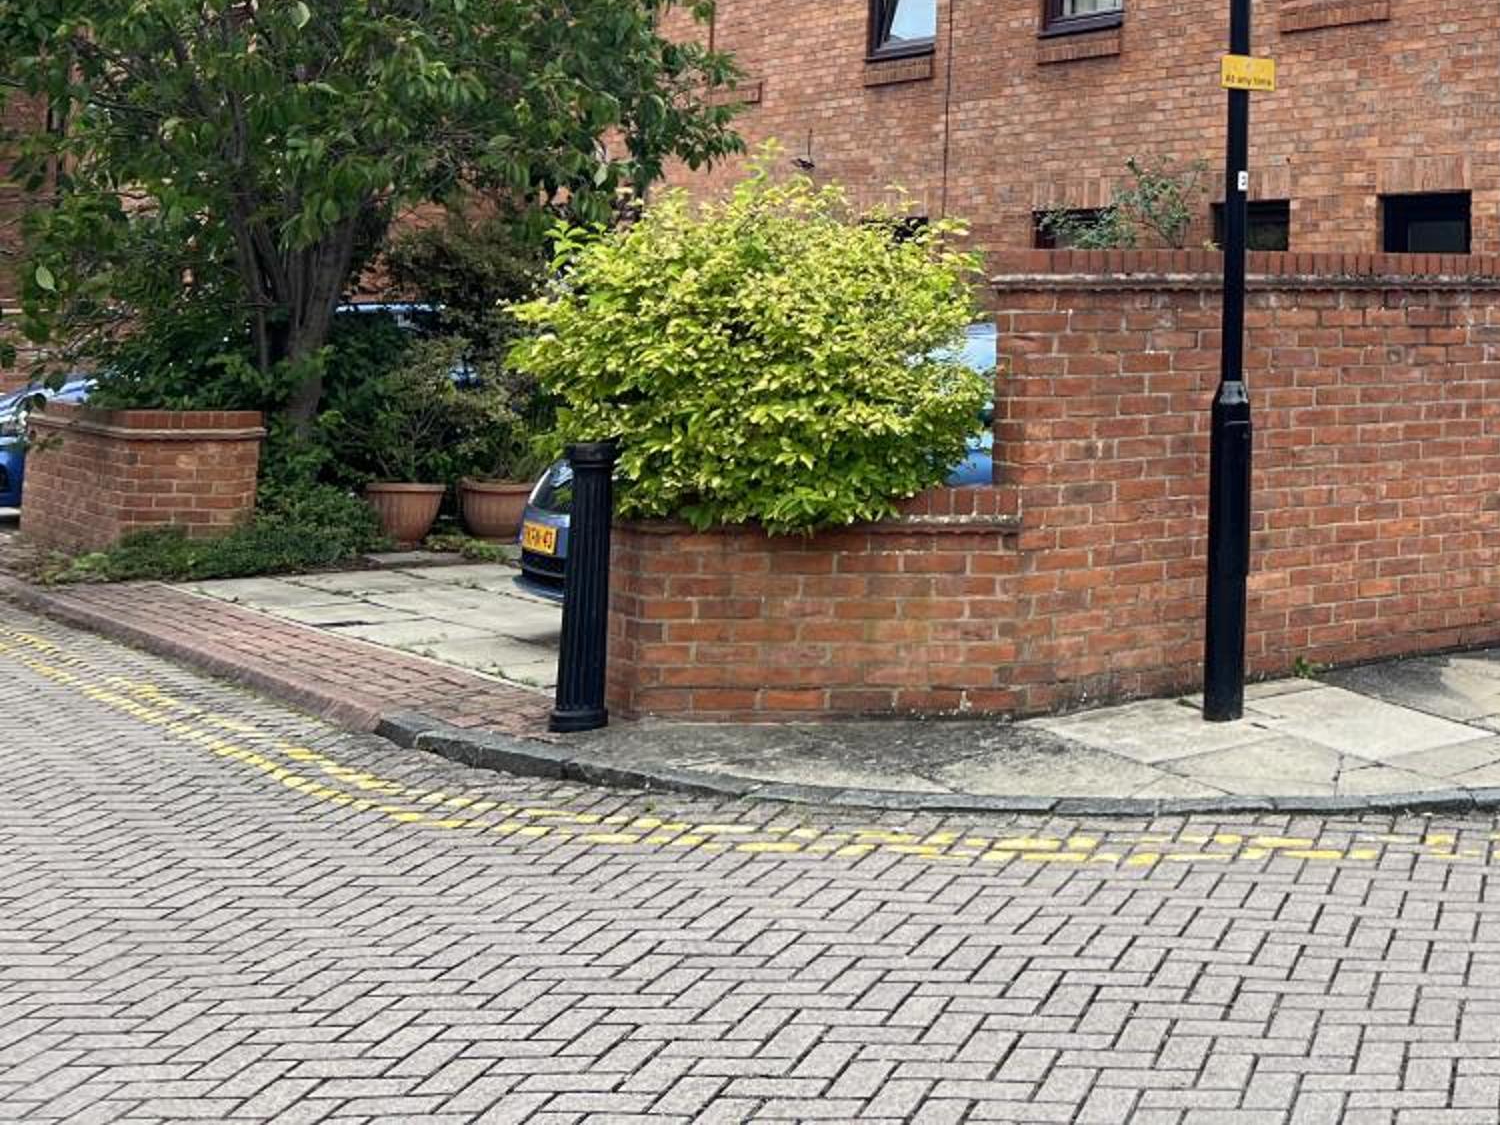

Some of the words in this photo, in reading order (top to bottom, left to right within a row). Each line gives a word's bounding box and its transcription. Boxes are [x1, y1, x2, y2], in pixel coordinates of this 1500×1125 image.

[1225, 74, 1235, 84] At
[1237, 76, 1253, 87] any
[1253, 76, 1273, 87] time
